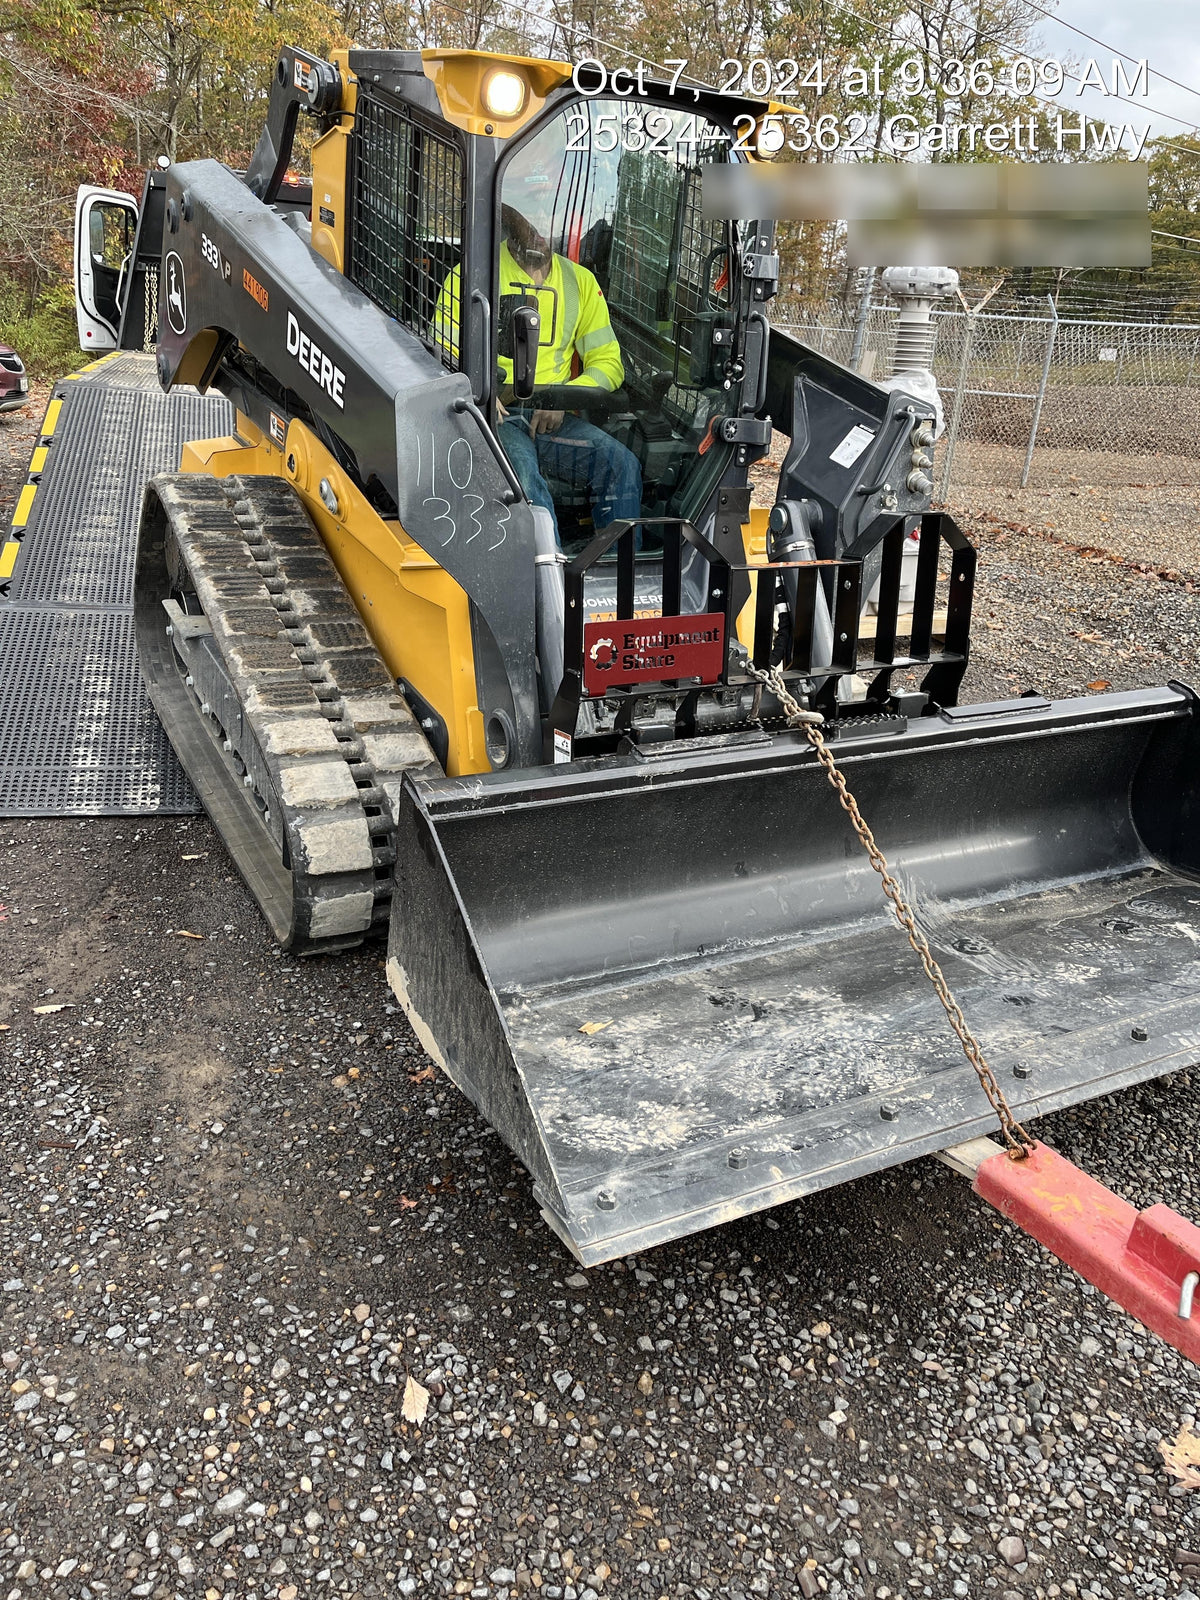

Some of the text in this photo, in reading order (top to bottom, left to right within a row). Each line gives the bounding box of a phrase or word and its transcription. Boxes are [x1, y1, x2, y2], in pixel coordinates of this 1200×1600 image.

[201, 232, 219, 269] 333
[286, 310, 346, 410] DEERE
[416, 433, 473, 497] 110
[422, 494, 512, 552] 333
[622, 653, 675, 671] Share
[623, 628, 720, 653] Equipment
